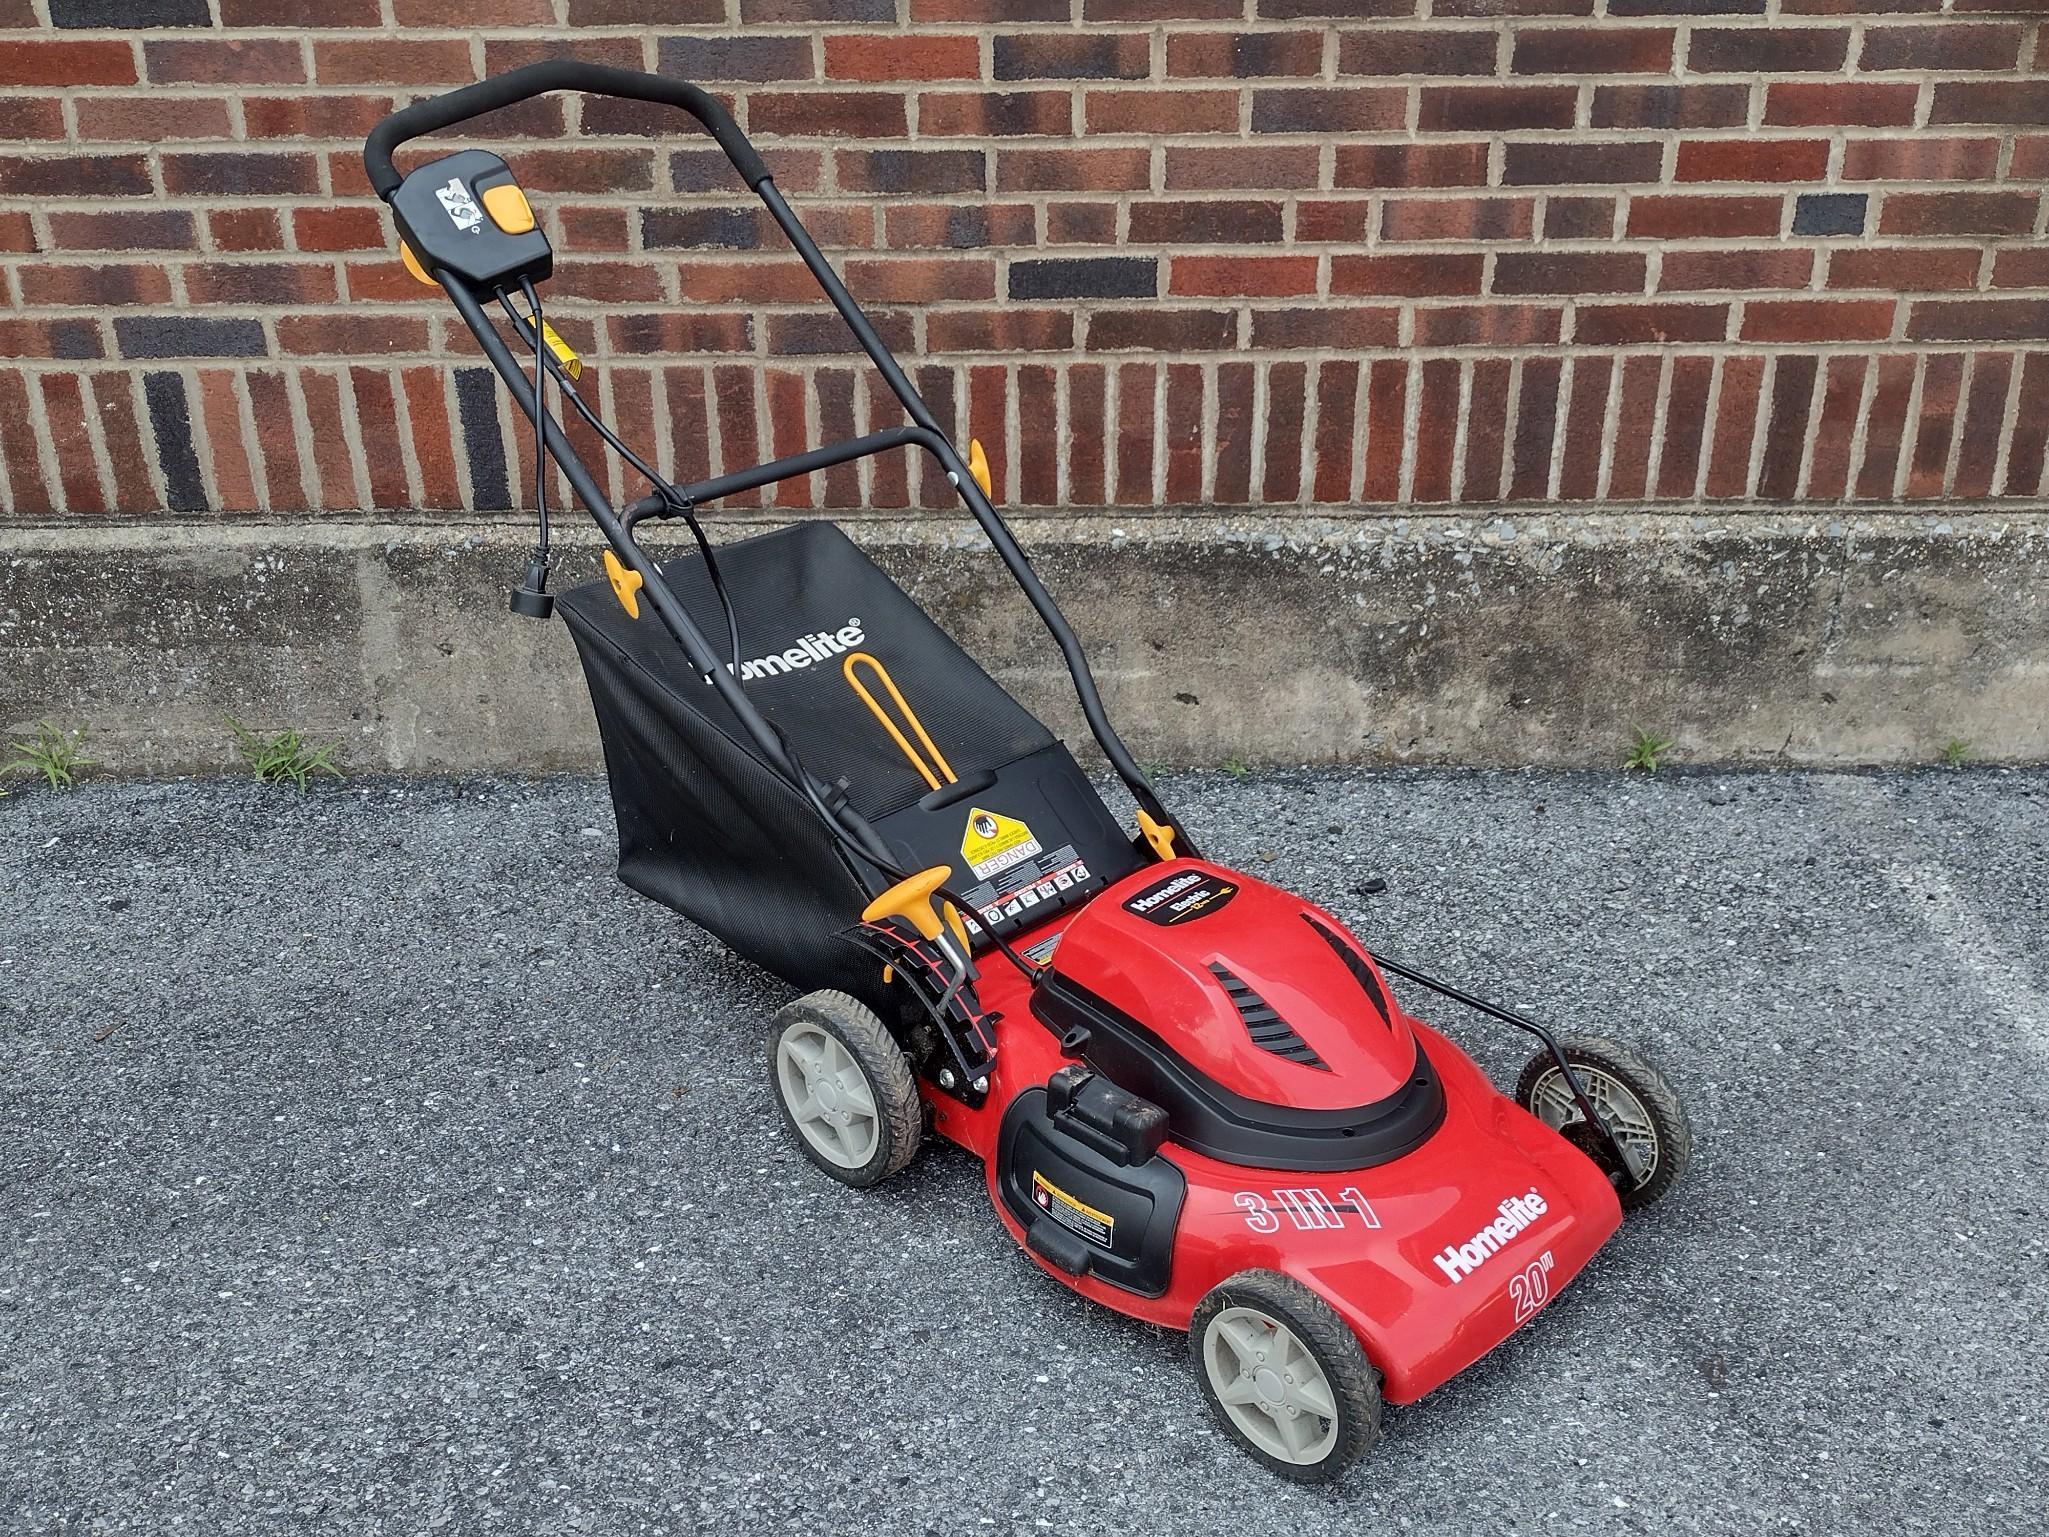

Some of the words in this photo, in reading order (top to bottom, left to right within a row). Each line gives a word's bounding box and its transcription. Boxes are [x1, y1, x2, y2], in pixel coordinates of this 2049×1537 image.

[980, 842, 1037, 875] DANGER
[1130, 874, 1202, 912] Homelite
[1169, 889, 1211, 912] Electric
[1233, 1191, 1280, 1234] 3
[1272, 1188, 1345, 1230] IN
[1339, 1187, 1382, 1230] 1
[1432, 1188, 1548, 1285] Homelite
[1508, 1250, 1554, 1324] 20"
